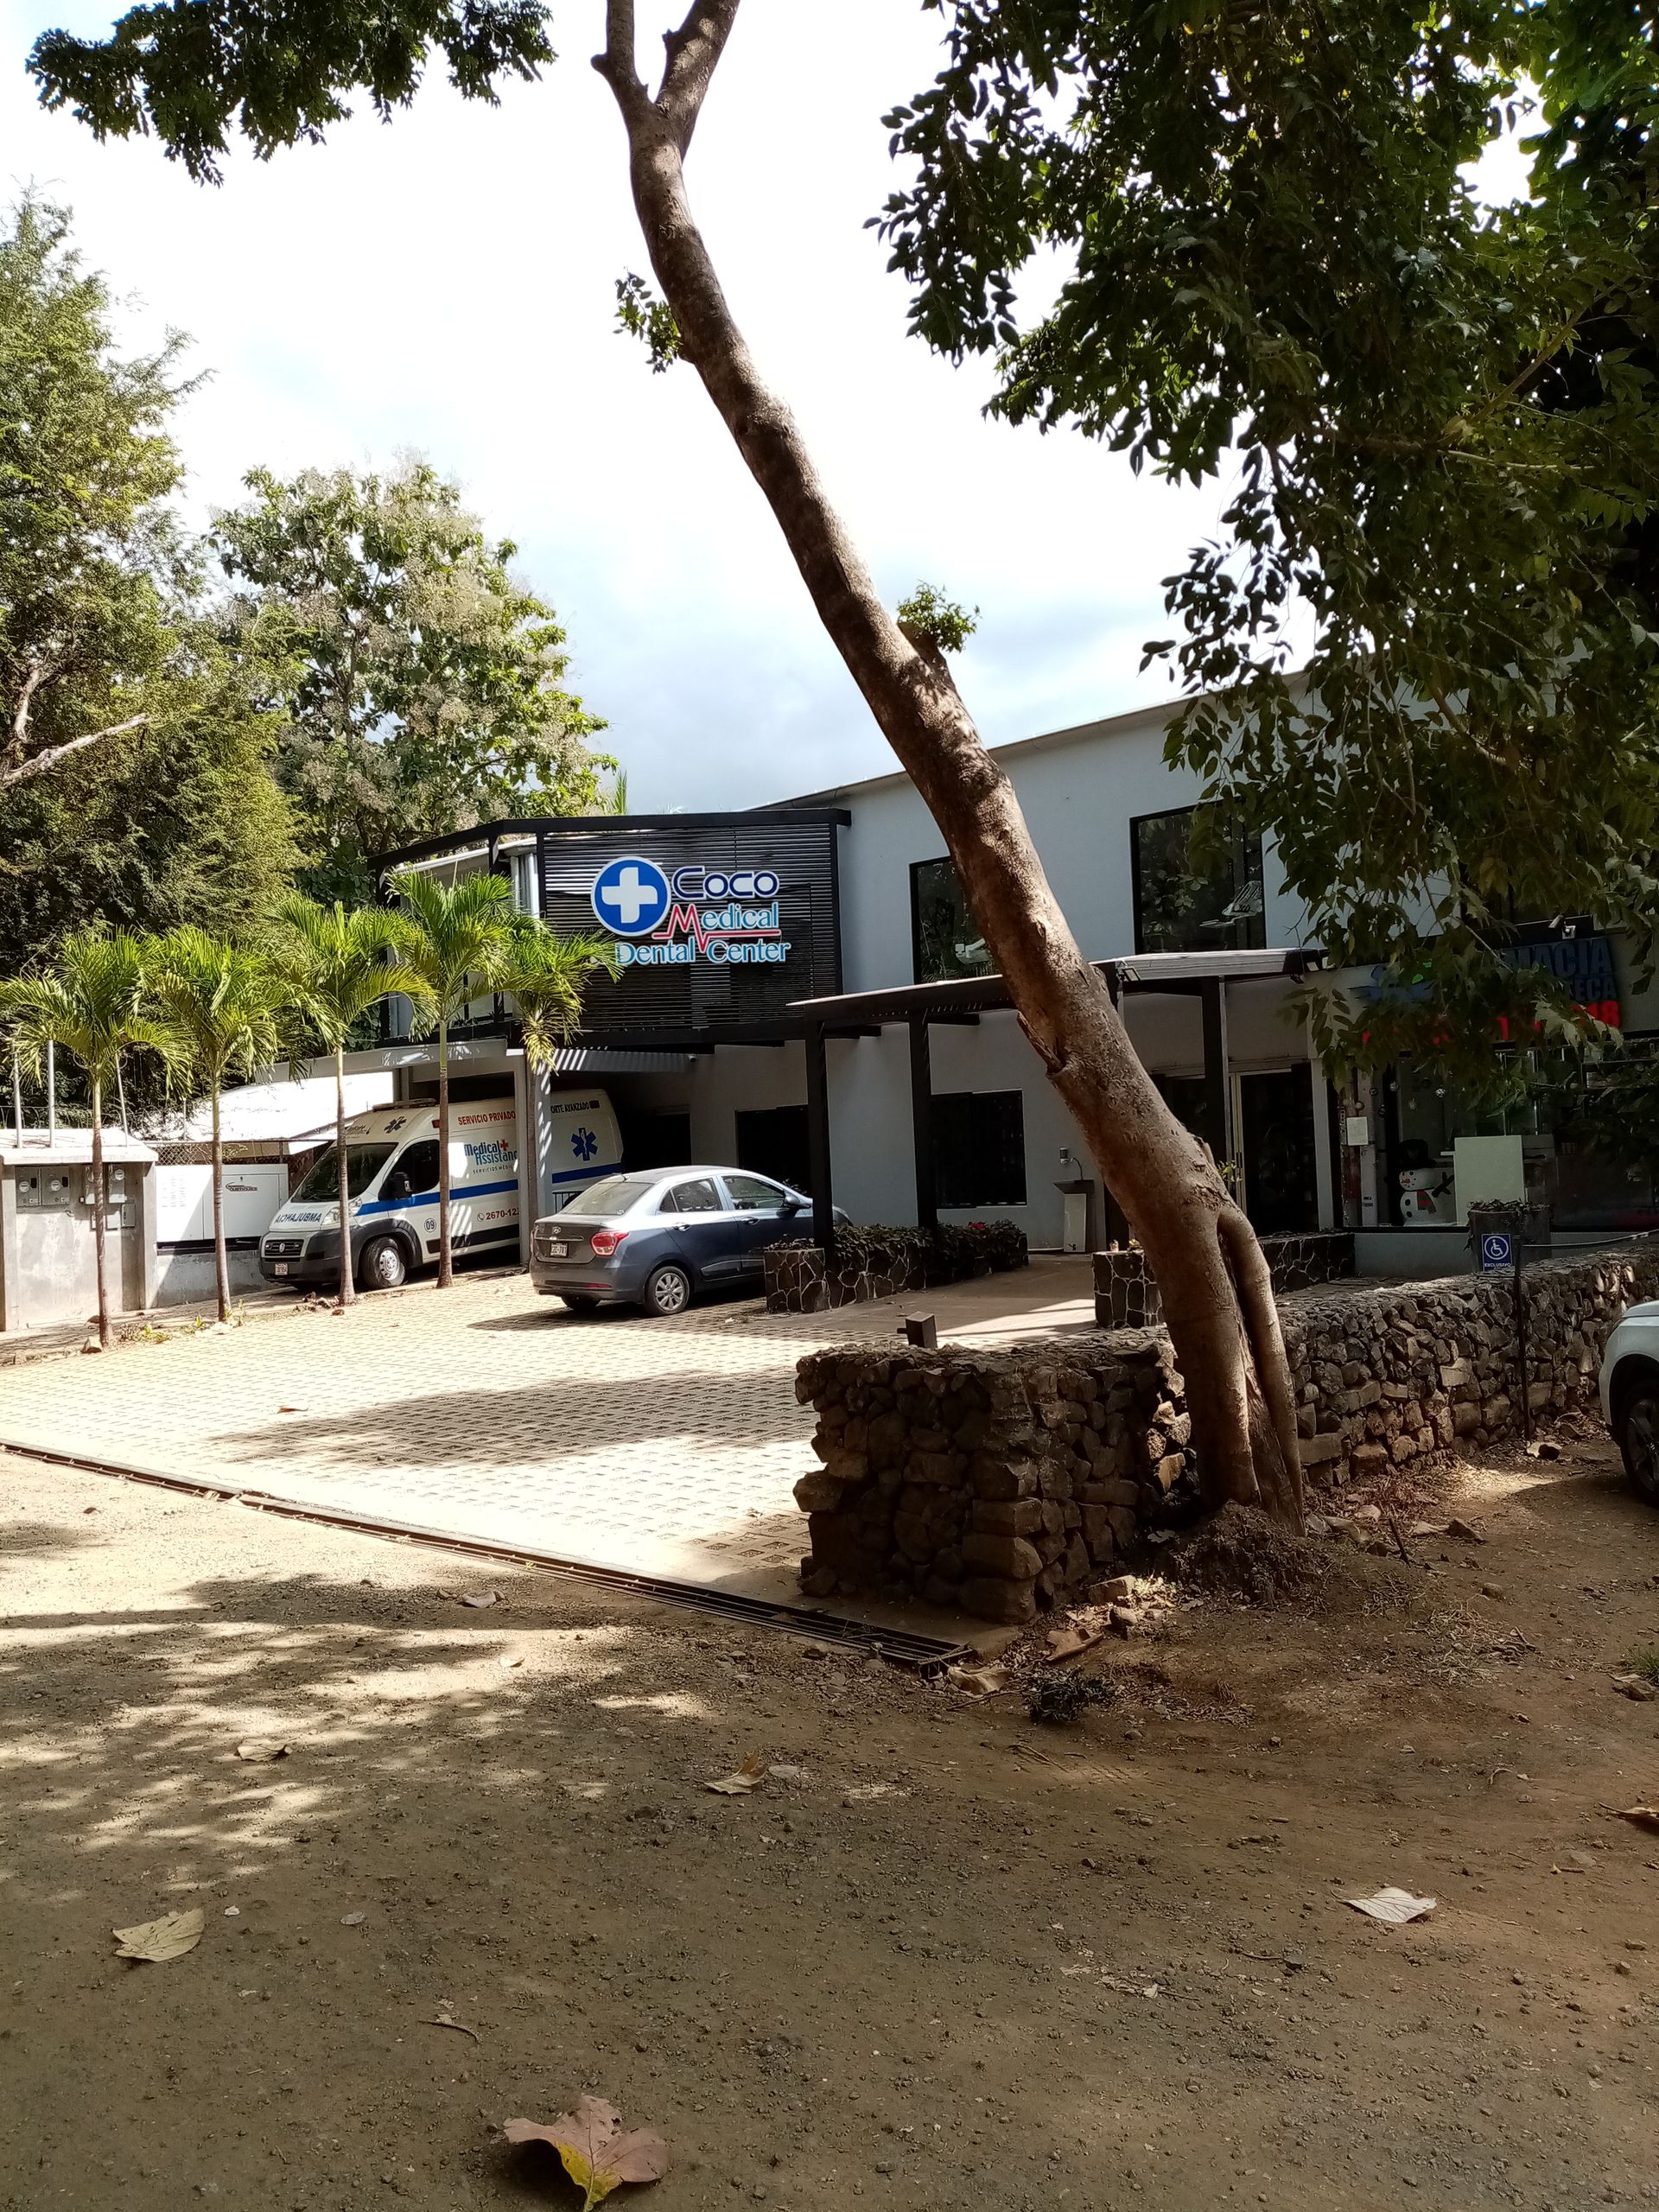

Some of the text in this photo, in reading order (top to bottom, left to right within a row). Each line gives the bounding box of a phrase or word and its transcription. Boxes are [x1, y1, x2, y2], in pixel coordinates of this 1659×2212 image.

[671, 865, 779, 900] Coco
[666, 901, 779, 936] Medical
[616, 936, 791, 966] Dental Center
[550, 1102, 590, 1115] ORTE AVANZADO
[457, 1110, 516, 1126] SERVICIO PRIVADO
[464, 1141, 501, 1156] Medical
[475, 1150, 518, 1166] Assistanc
[426, 1220, 435, 1230] 09
